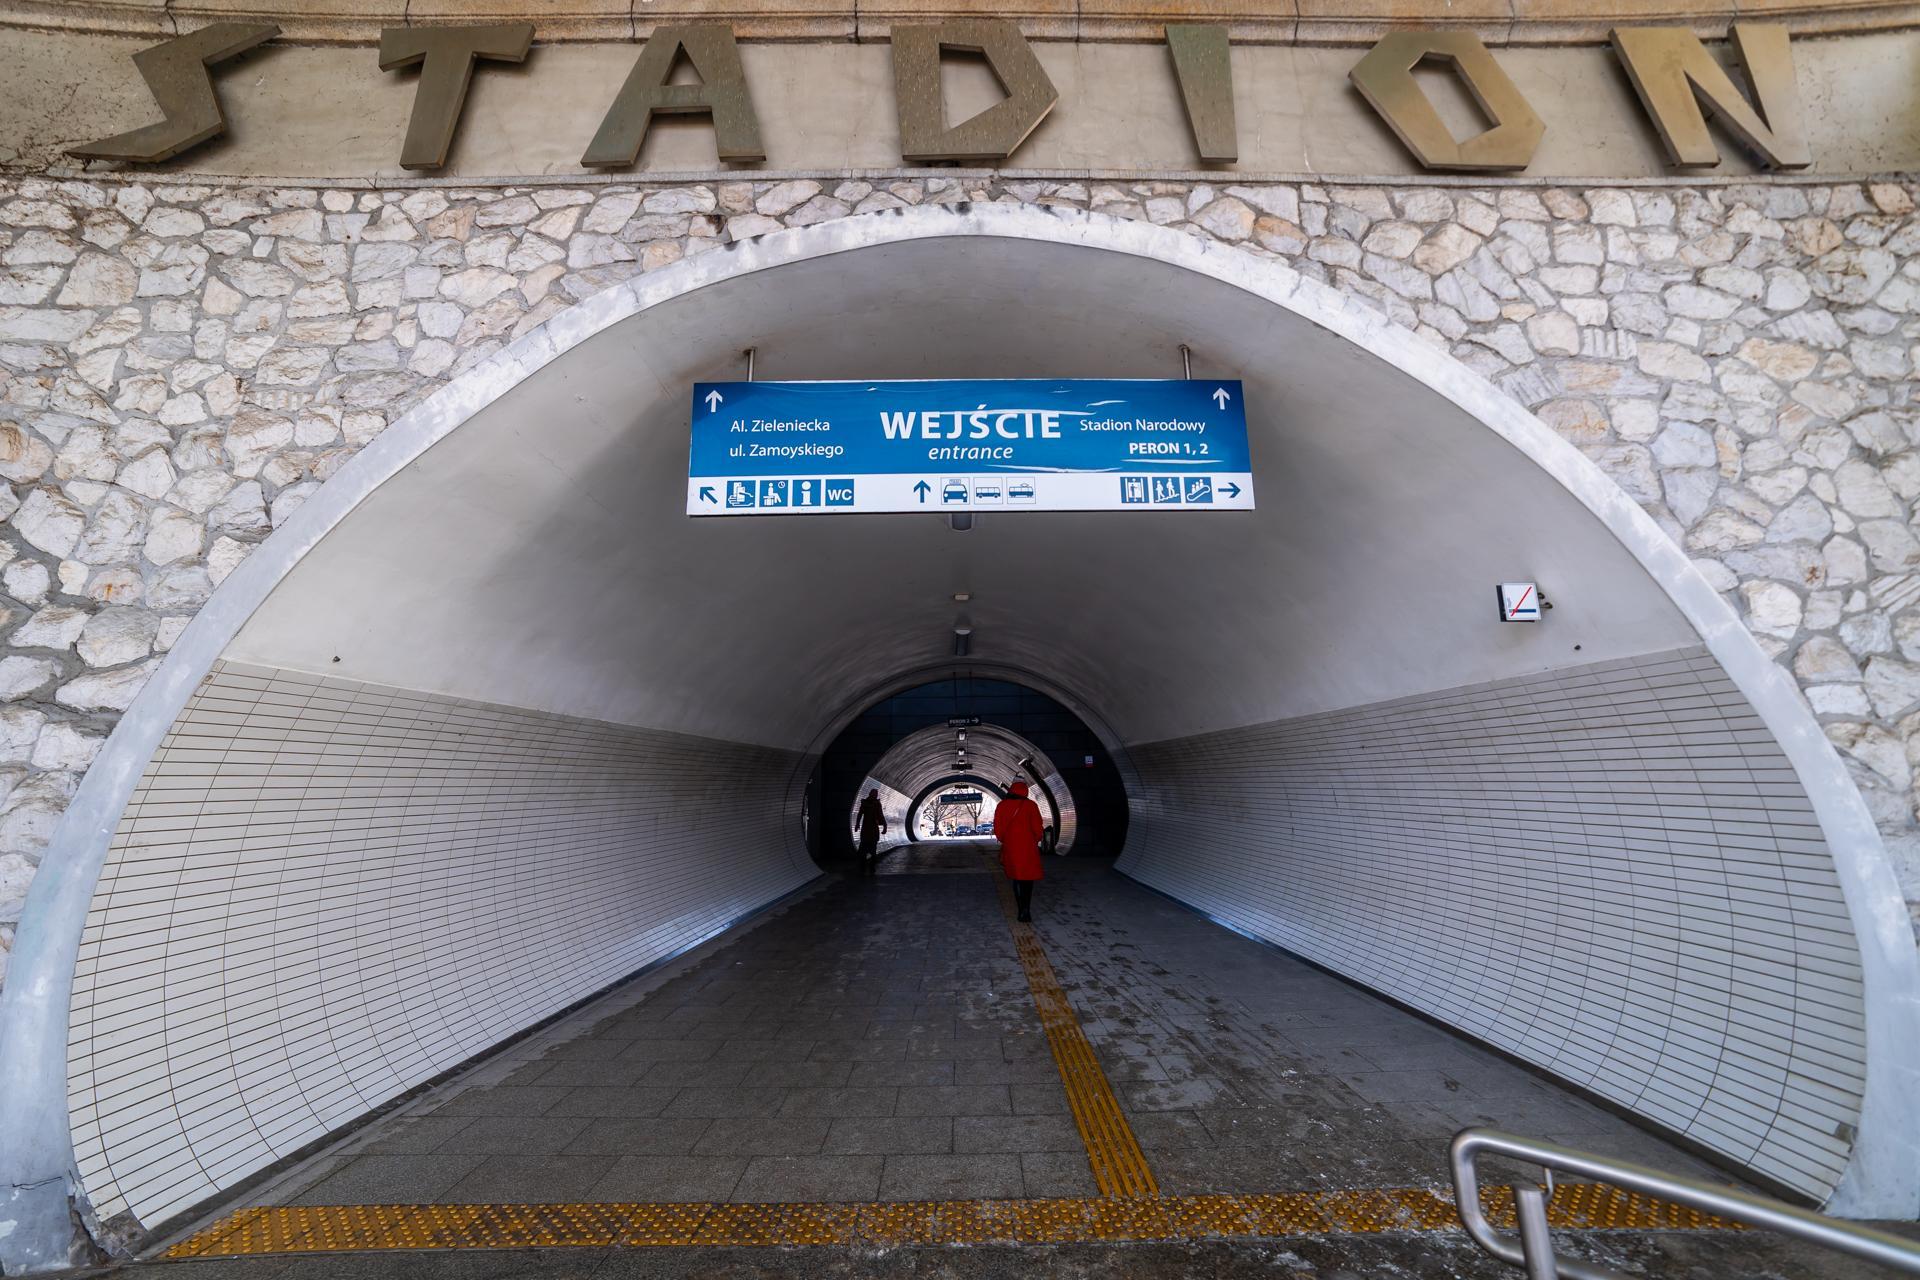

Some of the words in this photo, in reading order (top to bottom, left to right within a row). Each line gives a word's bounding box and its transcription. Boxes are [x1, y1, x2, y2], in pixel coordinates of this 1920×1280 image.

[66, 21, 1811, 170] STADION
[730, 419, 748, 433] Al.
[751, 418, 831, 433] Zieleniecka
[879, 403, 1062, 440] WEJŚCIE
[1079, 418, 1133, 432] Stadion
[1135, 418, 1206, 434] Narodowy
[729, 444, 746, 458] ul.
[749, 442, 844, 459] Zamoyskiego
[928, 445, 1014, 460] entrance
[1129, 442, 1180, 455] PERON
[1183, 442, 1197, 456] 1,
[1199, 443, 1209, 455] 2
[827, 488, 853, 501] WC
